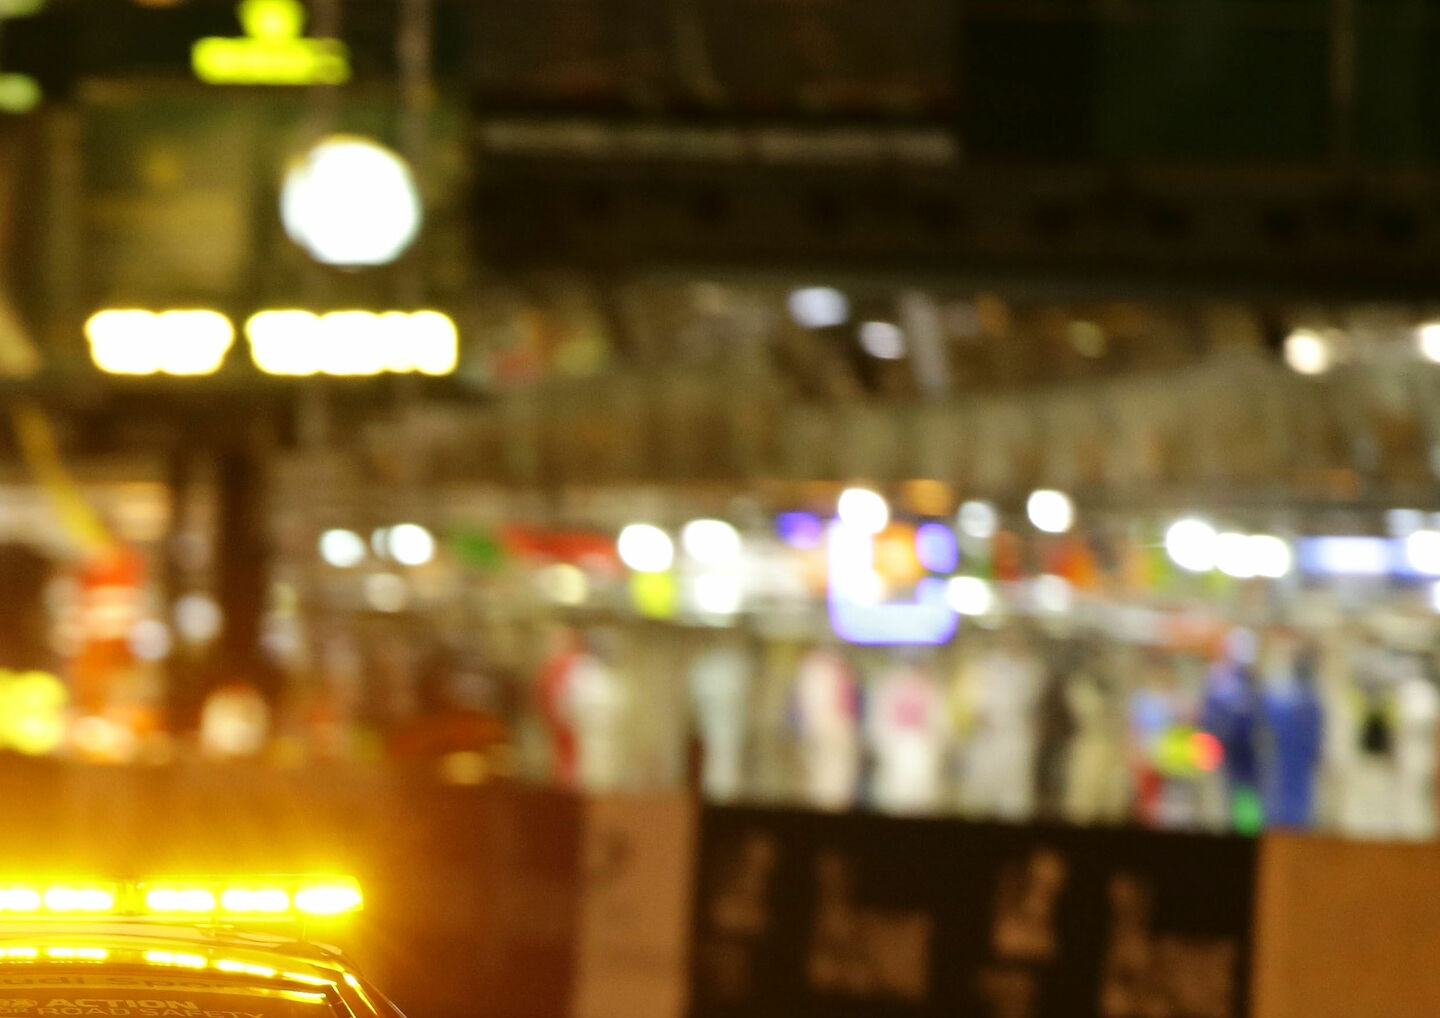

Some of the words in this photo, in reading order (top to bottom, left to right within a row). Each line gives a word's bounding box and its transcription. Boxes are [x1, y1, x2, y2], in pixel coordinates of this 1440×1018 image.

[106, 977, 236, 989] Spo
[45, 999, 200, 1010] ACTION
[37, 1007, 131, 1016] ROAD
